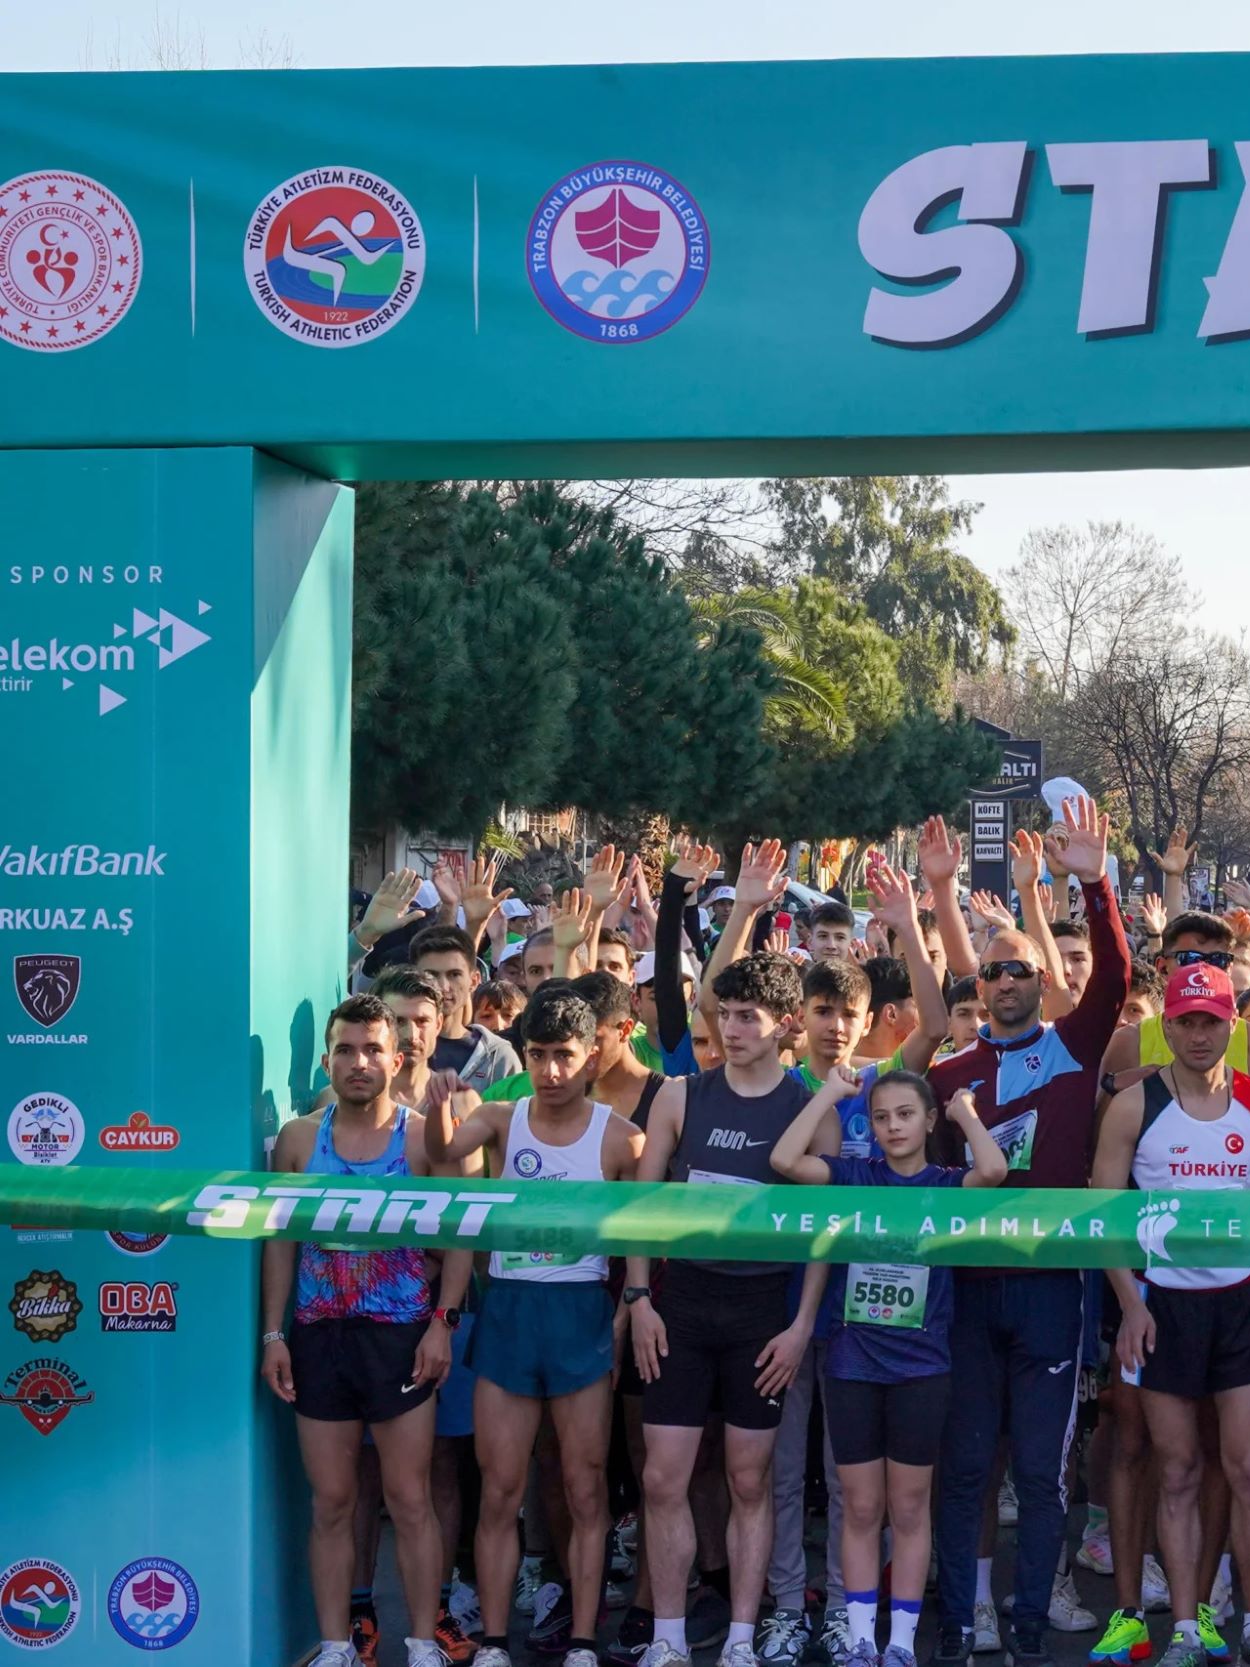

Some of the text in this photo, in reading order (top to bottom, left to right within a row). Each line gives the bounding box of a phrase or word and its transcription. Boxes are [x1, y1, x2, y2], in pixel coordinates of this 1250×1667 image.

[247, 169, 421, 251] TÜRKİYE ATLETİZM FEDERASYONU
[533, 196, 564, 273] TRABZON
[560, 167, 663, 198] BÜYÜKŞEHİR
[37, 206, 83, 222] GENÇLİK
[84, 218, 96, 234] VE
[92, 232, 108, 263] SPOR
[253, 270, 418, 342] TURKISH ATHLETIC FEDERATION
[323, 311, 349, 322] 1922
[600, 323, 639, 338] 1868
[10, 565, 163, 584] SPONSOR
[998, 763, 1036, 776] ALTI
[978, 805, 1001, 815] KÖFTE
[978, 826, 1000, 835] BALIK
[92, 908, 134, 936] A.Ş
[19, 959, 76, 968] PEUGEOT
[1179, 985, 1216, 997] TÜRKİYE
[7, 1034, 89, 1045] VARDALLAR
[23, 1097, 69, 1114] GEDİKLİ
[31, 1143, 59, 1151] MOTOR
[105, 1131, 174, 1148] ÇAYKUR
[706, 1128, 747, 1151] RUN
[1169, 1144, 1189, 1154] TAF
[1169, 1160, 1248, 1177] TÜRKİYE
[186, 1184, 517, 1237] START
[771, 1211, 1105, 1239] YEŞİL ADIMLAR
[99, 1282, 176, 1316] OBA
[854, 1281, 915, 1308] 5580
[16, 1296, 71, 1319] Bikka
[104, 1315, 173, 1331] Makarna
[4, 1357, 87, 1390] Terminal
